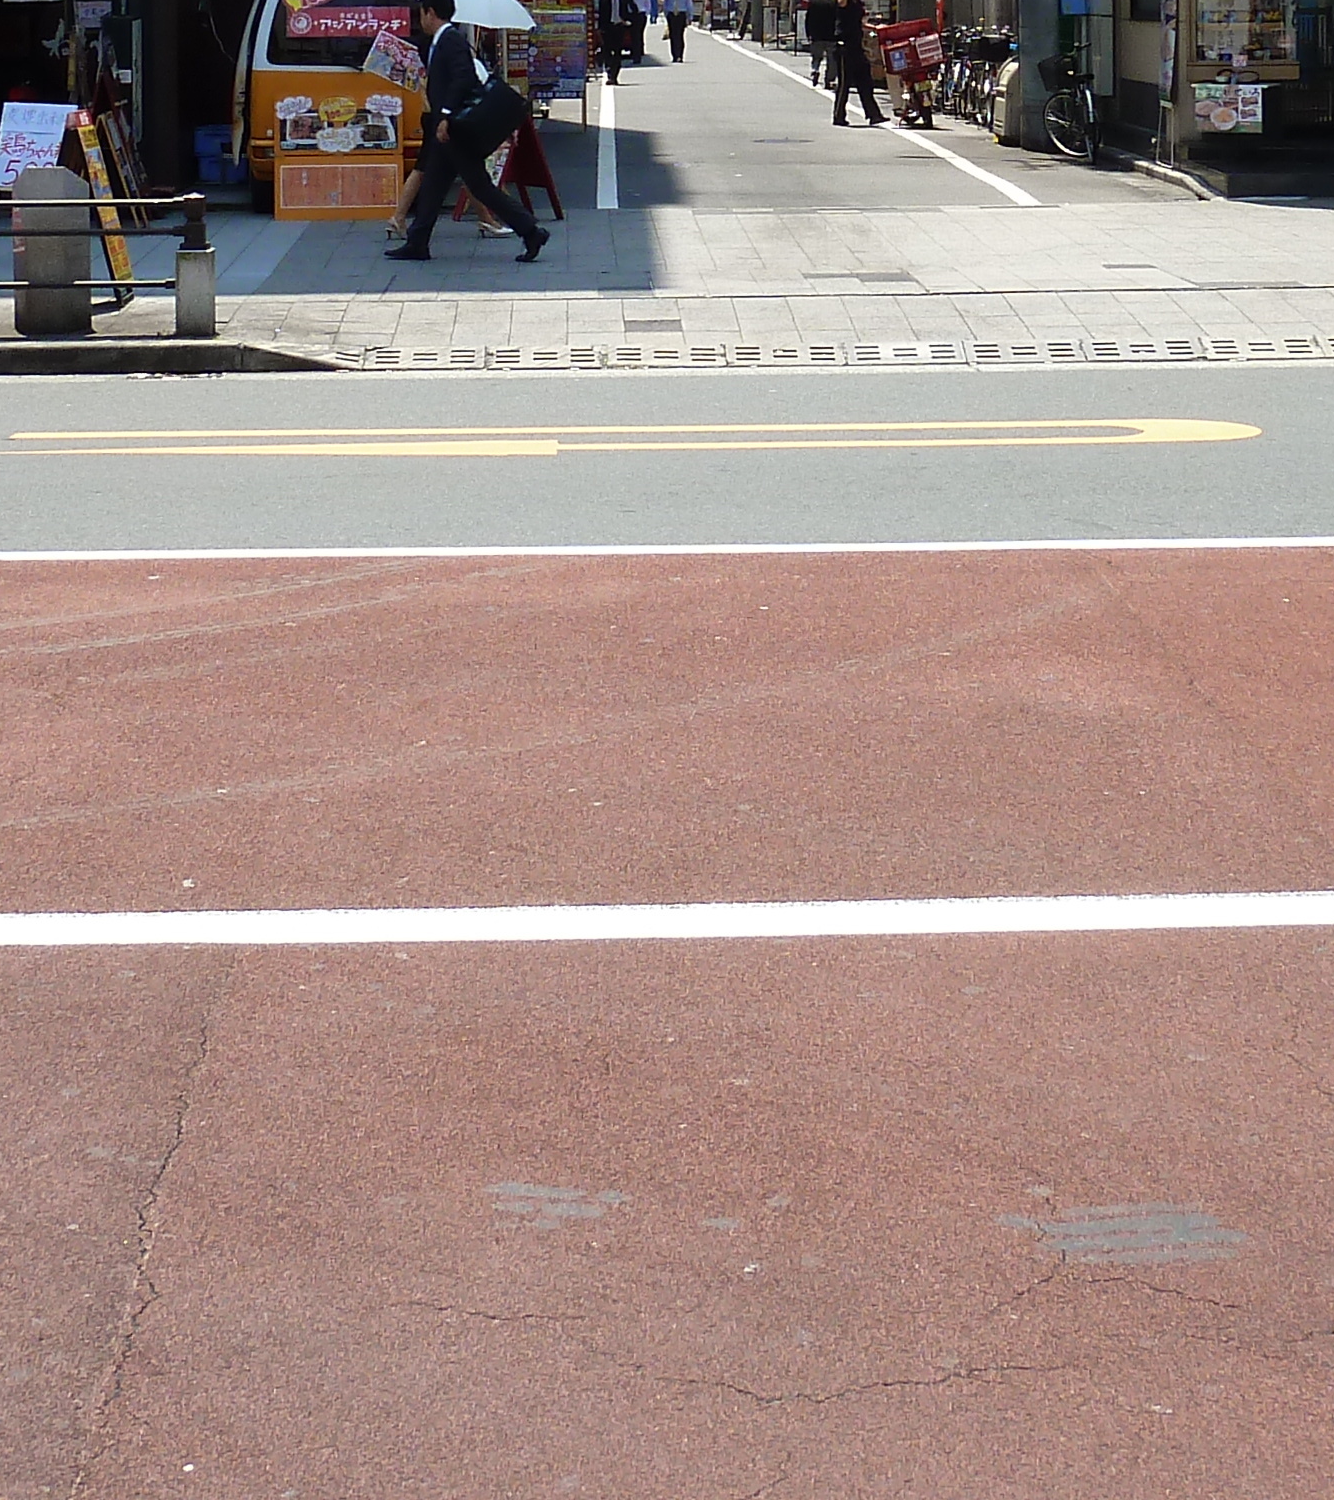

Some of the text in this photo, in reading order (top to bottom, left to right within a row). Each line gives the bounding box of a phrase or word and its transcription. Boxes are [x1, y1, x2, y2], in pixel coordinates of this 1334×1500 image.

[319, 19, 402, 30] アジアンランチ
